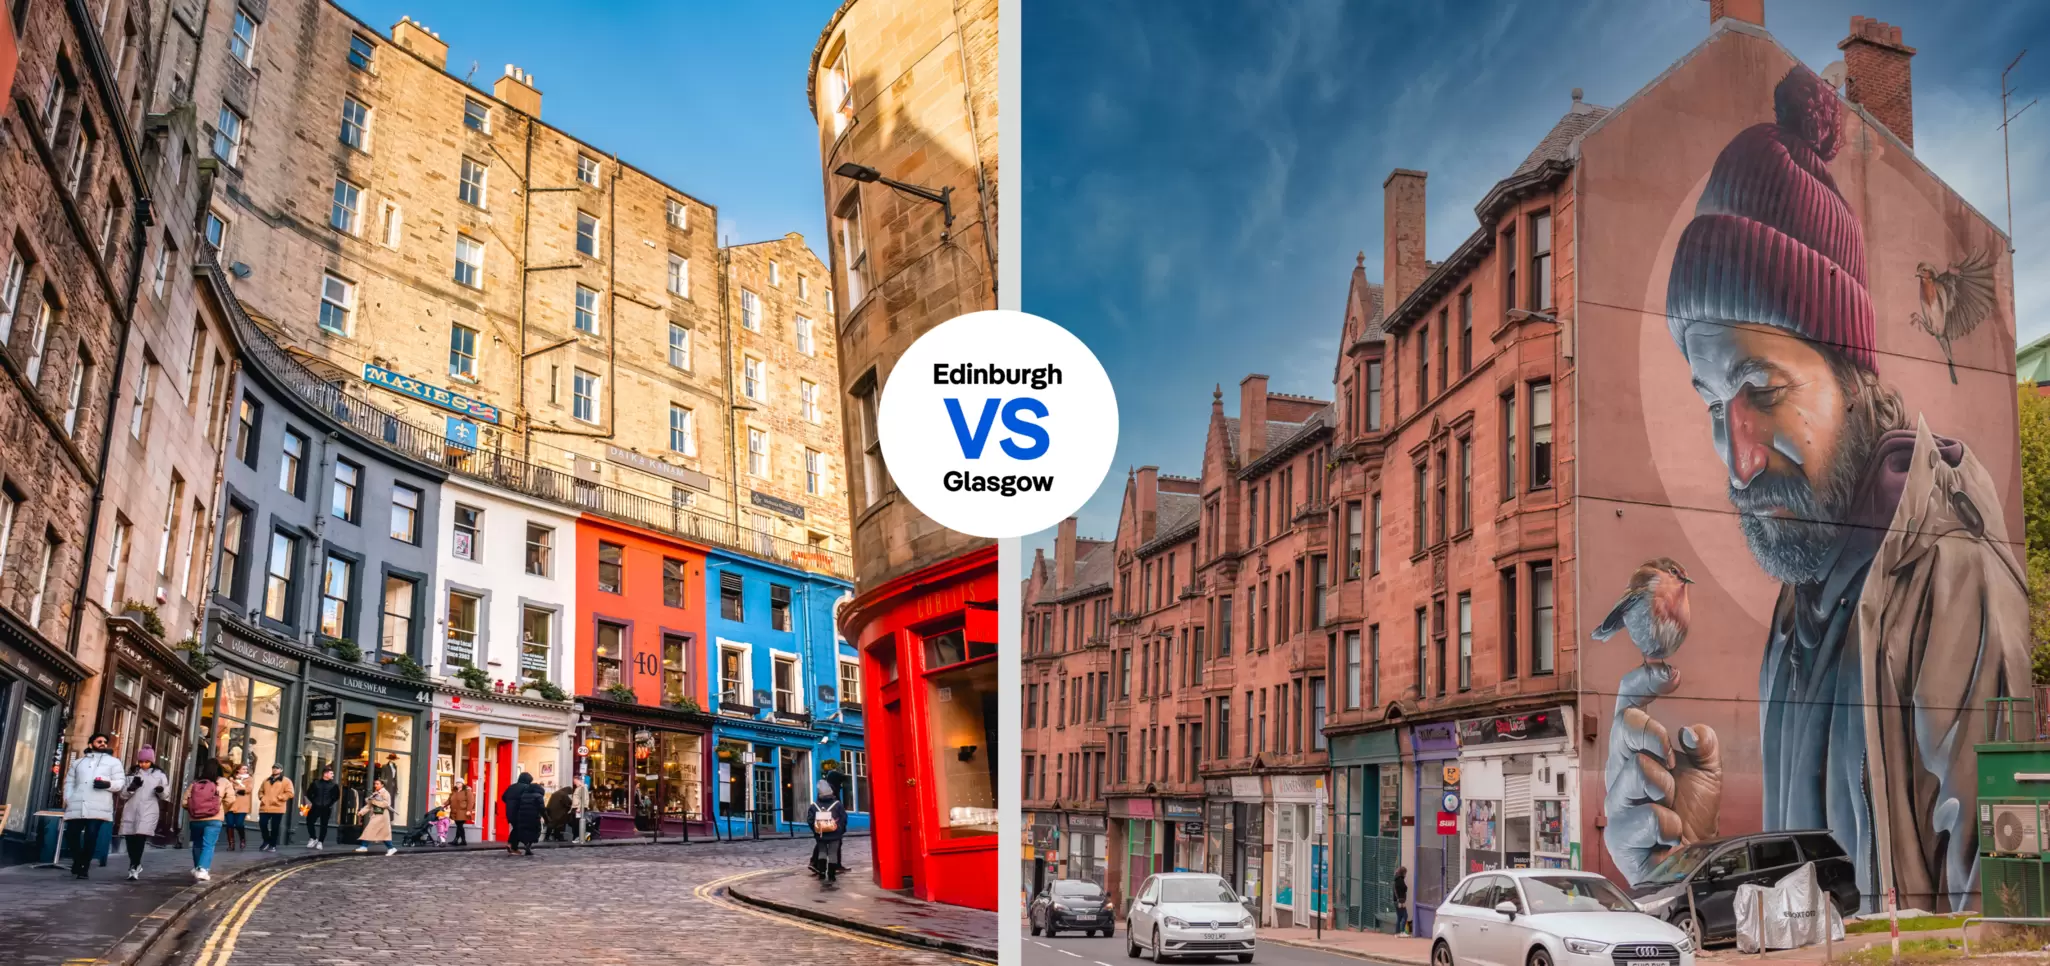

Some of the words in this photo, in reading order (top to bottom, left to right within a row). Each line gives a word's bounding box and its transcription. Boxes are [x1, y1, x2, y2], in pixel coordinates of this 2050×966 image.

[366, 367, 469, 410] MAXIES
[231, 639, 258, 659] Walker
[262, 651, 289, 669] Slater
[633, 651, 658, 676] 40
[343, 676, 387, 695] LADIESWEAR
[475, 703, 494, 713] gallery
